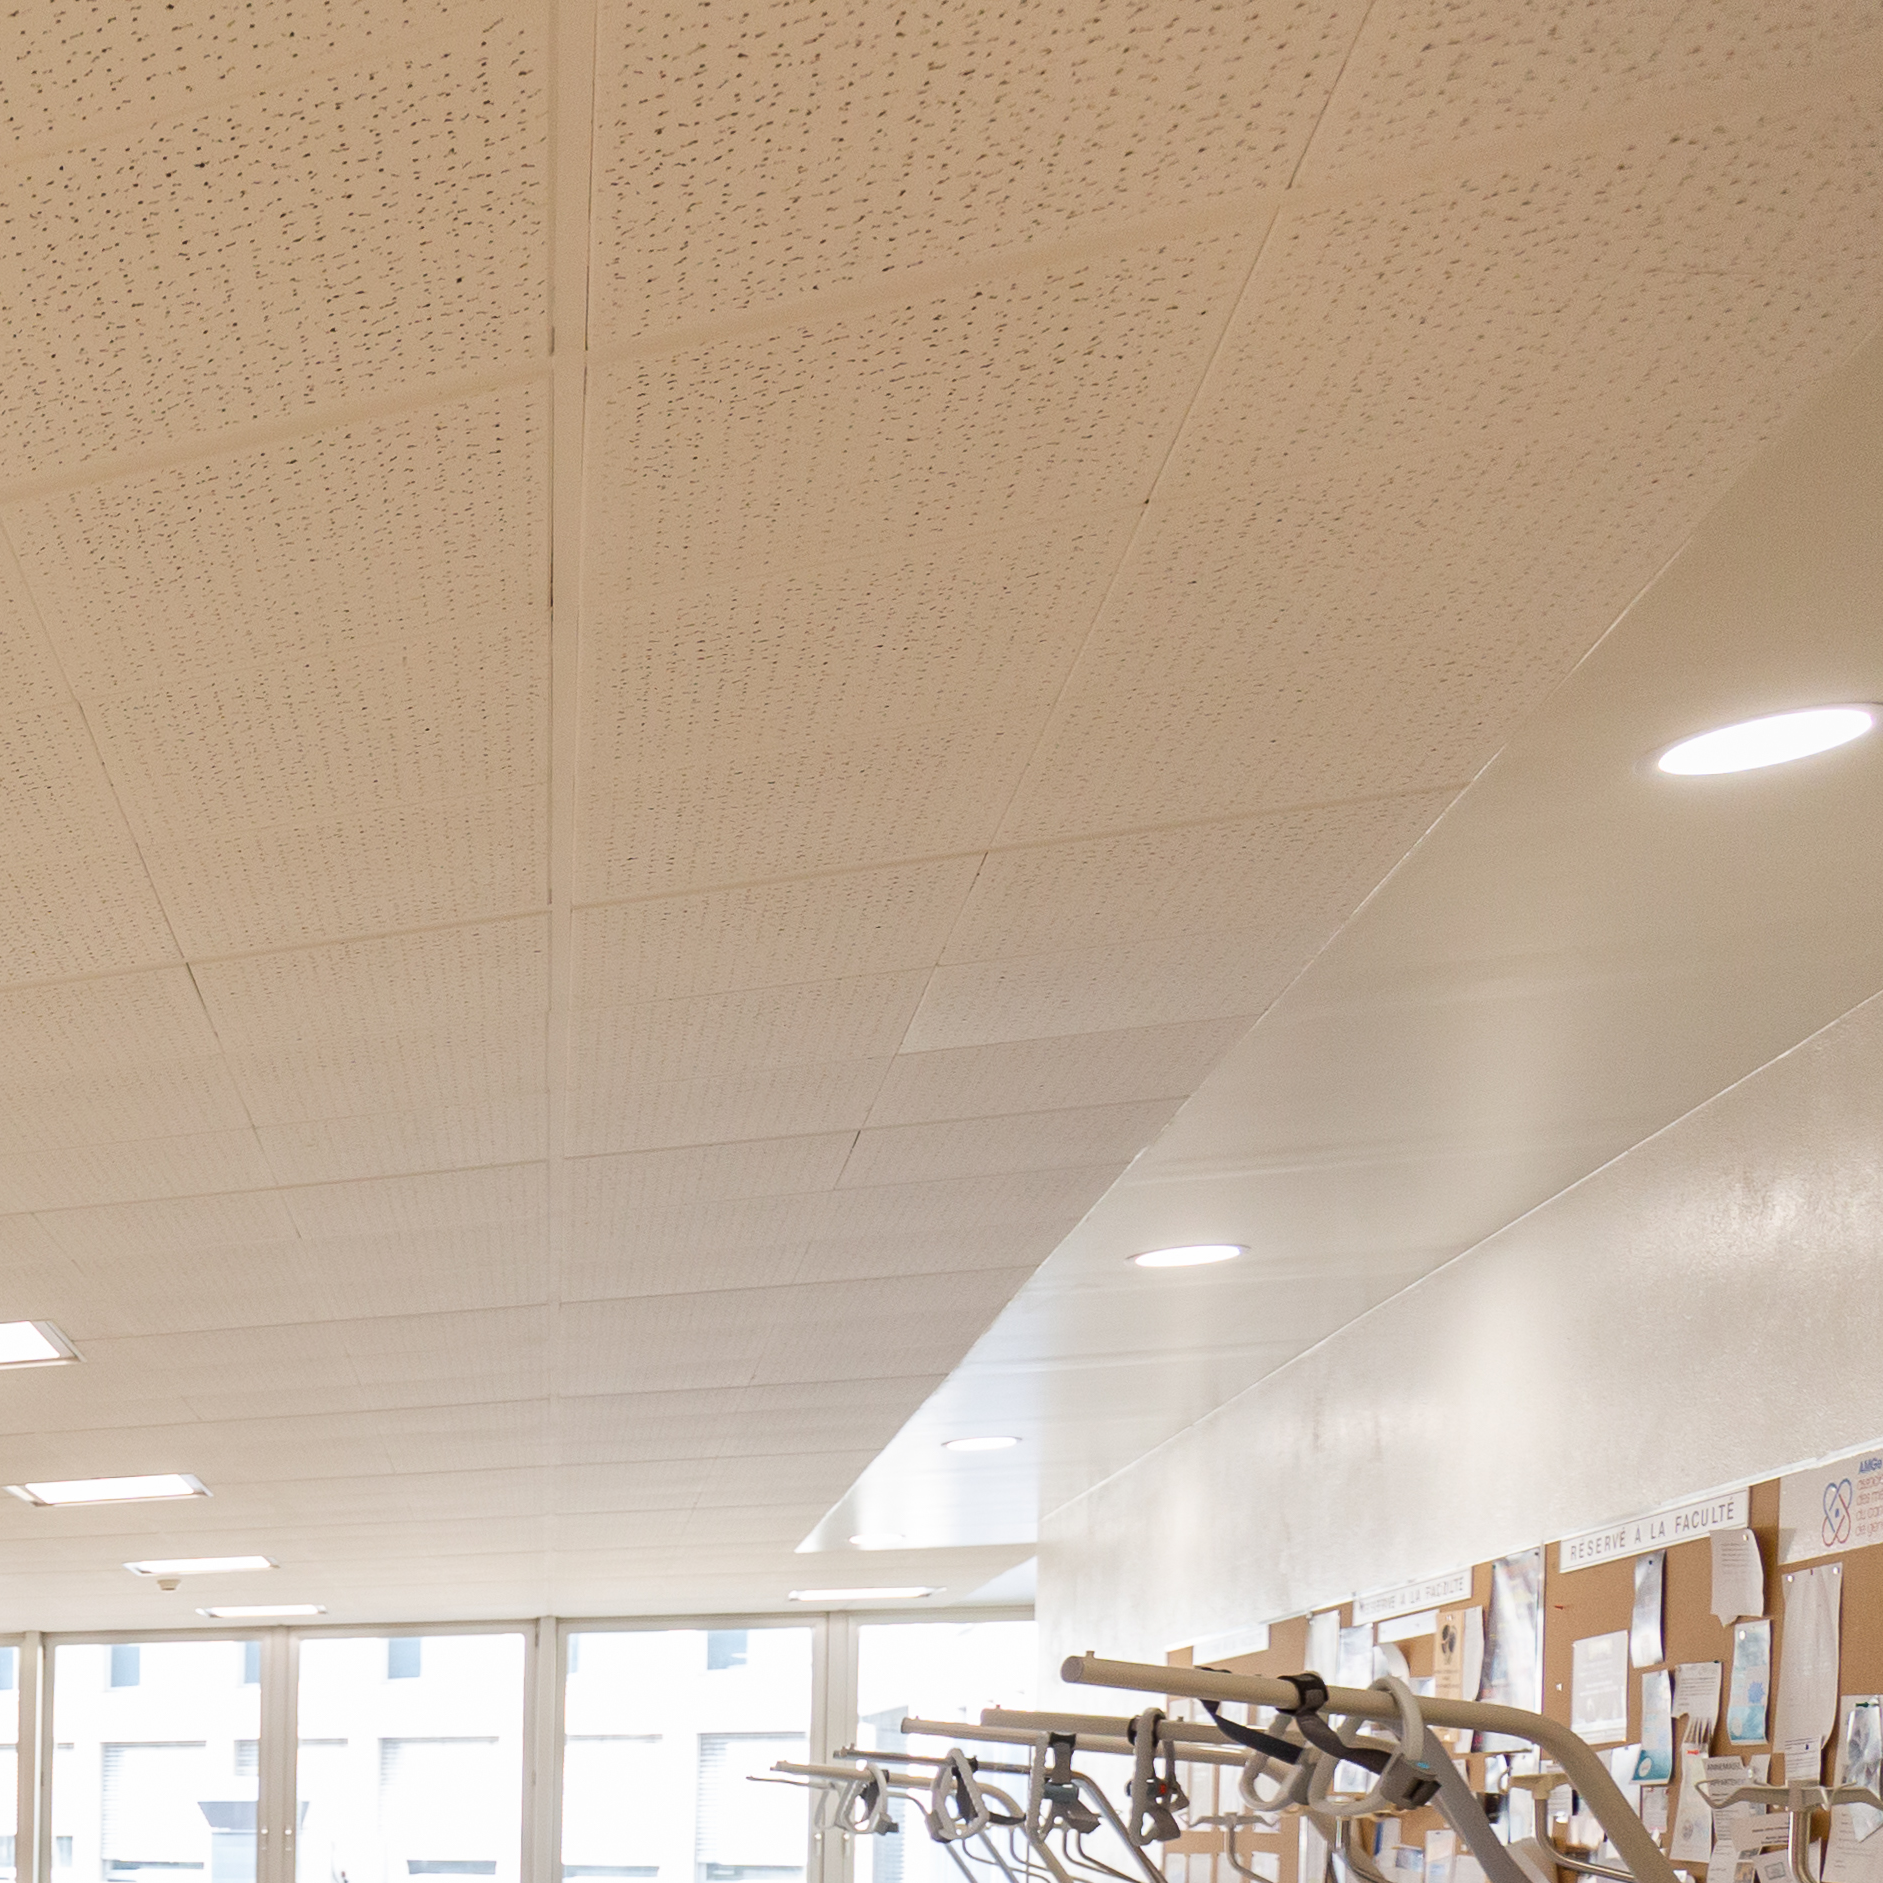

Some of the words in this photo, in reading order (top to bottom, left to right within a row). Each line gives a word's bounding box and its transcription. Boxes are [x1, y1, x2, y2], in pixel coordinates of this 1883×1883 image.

[1570, 1526, 1626, 1560] RÉSERVÉ
[1650, 1520, 1666, 1539] LA
[1675, 1496, 1735, 1534] FACULTÉ
